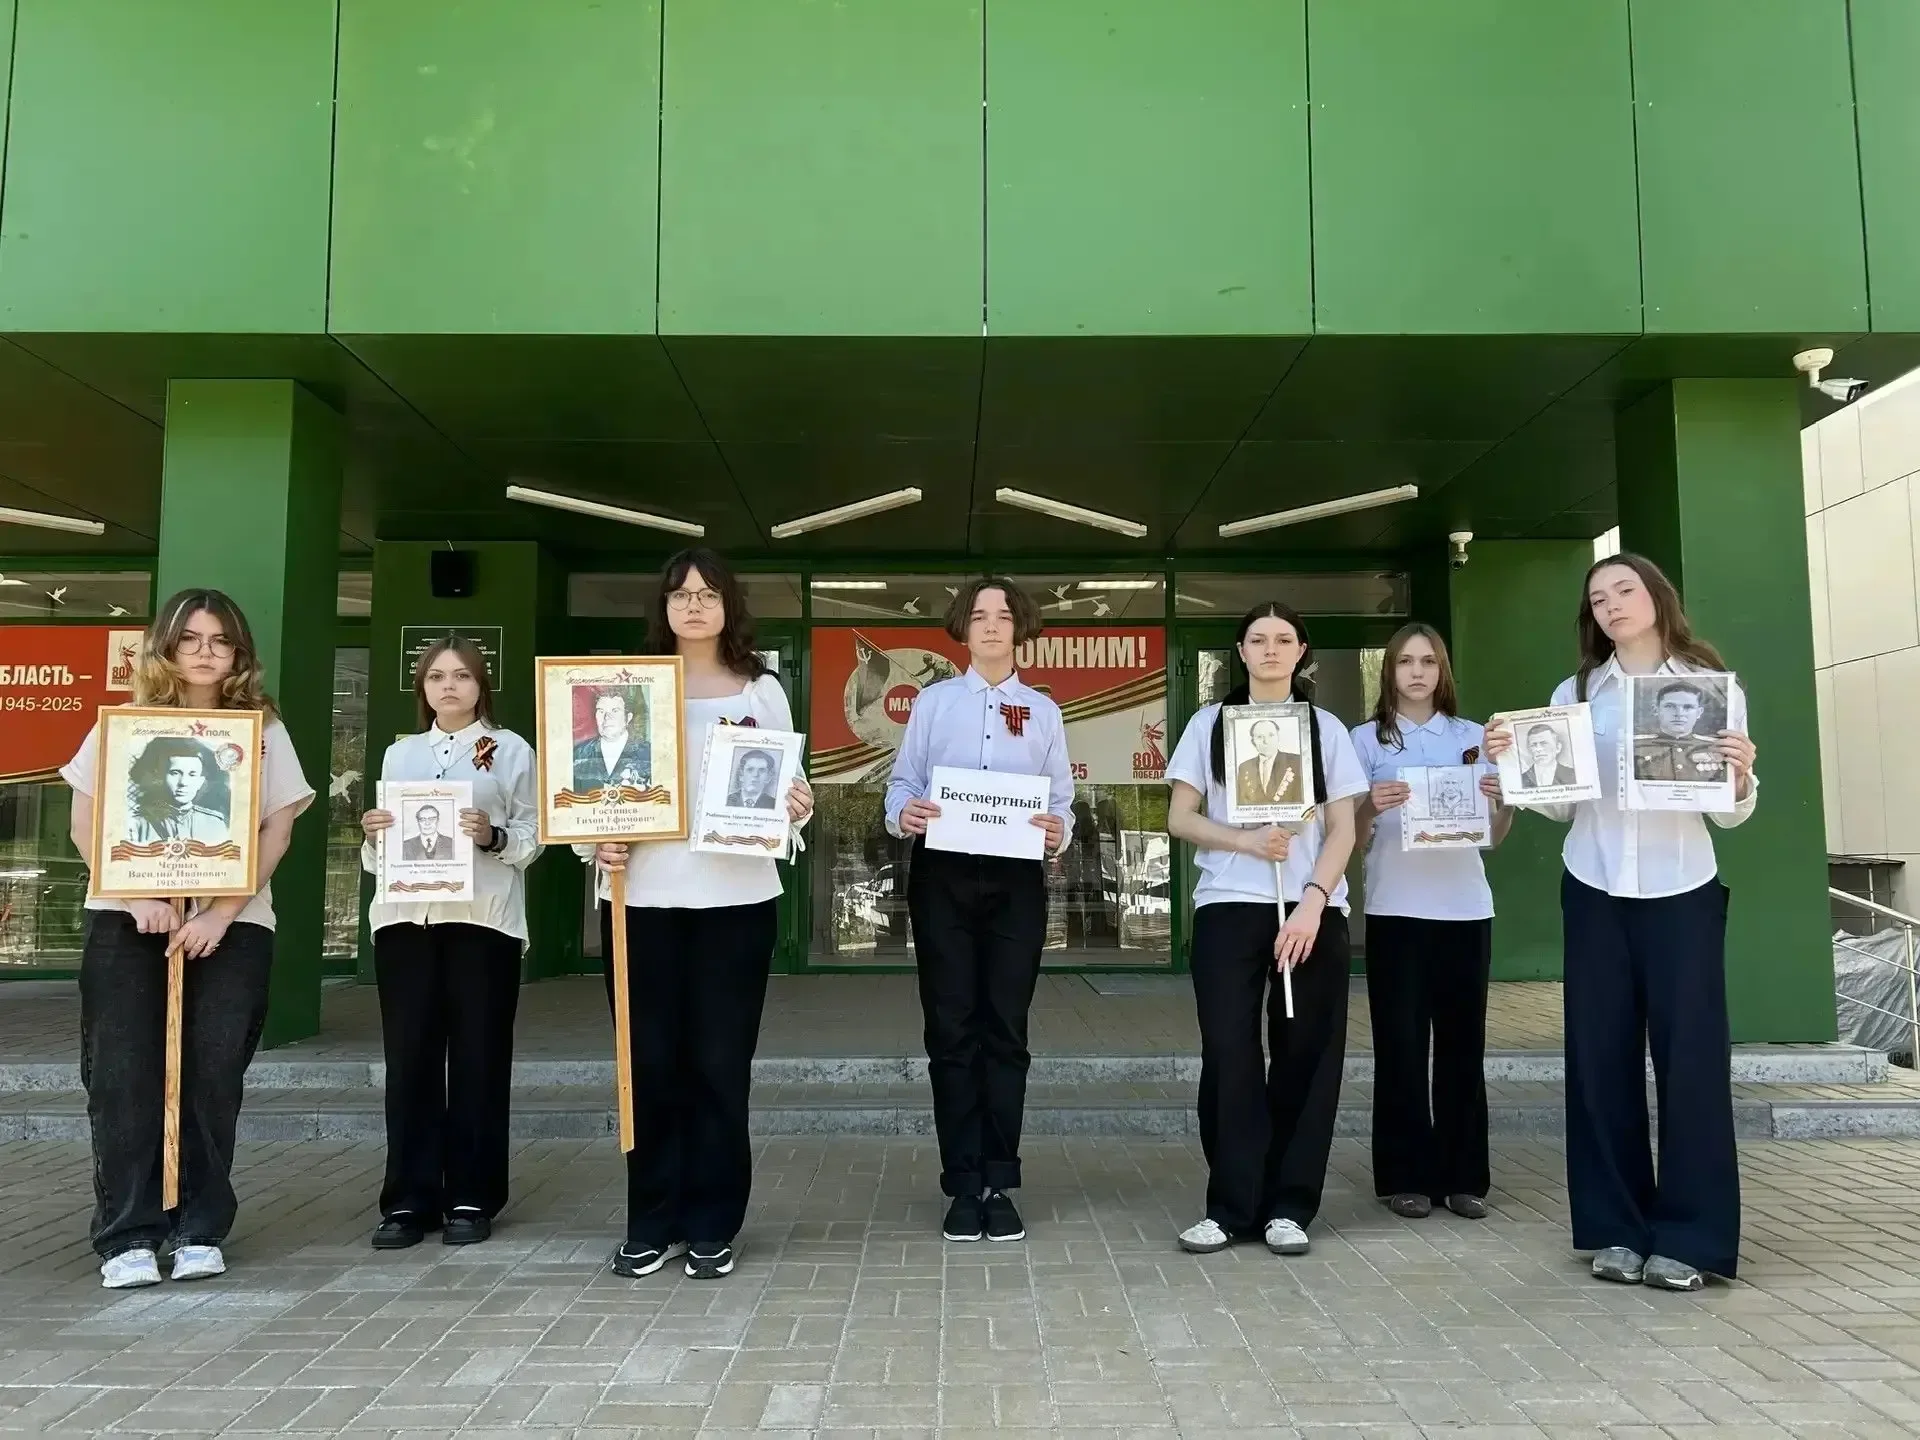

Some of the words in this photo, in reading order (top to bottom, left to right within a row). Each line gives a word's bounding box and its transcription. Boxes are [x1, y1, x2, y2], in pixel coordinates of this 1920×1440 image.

[940, 786, 1042, 809] Бессмертный
[970, 812, 1007, 825] полк
[128, 870, 173, 878] Василий
[176, 869, 227, 878] Иванович
